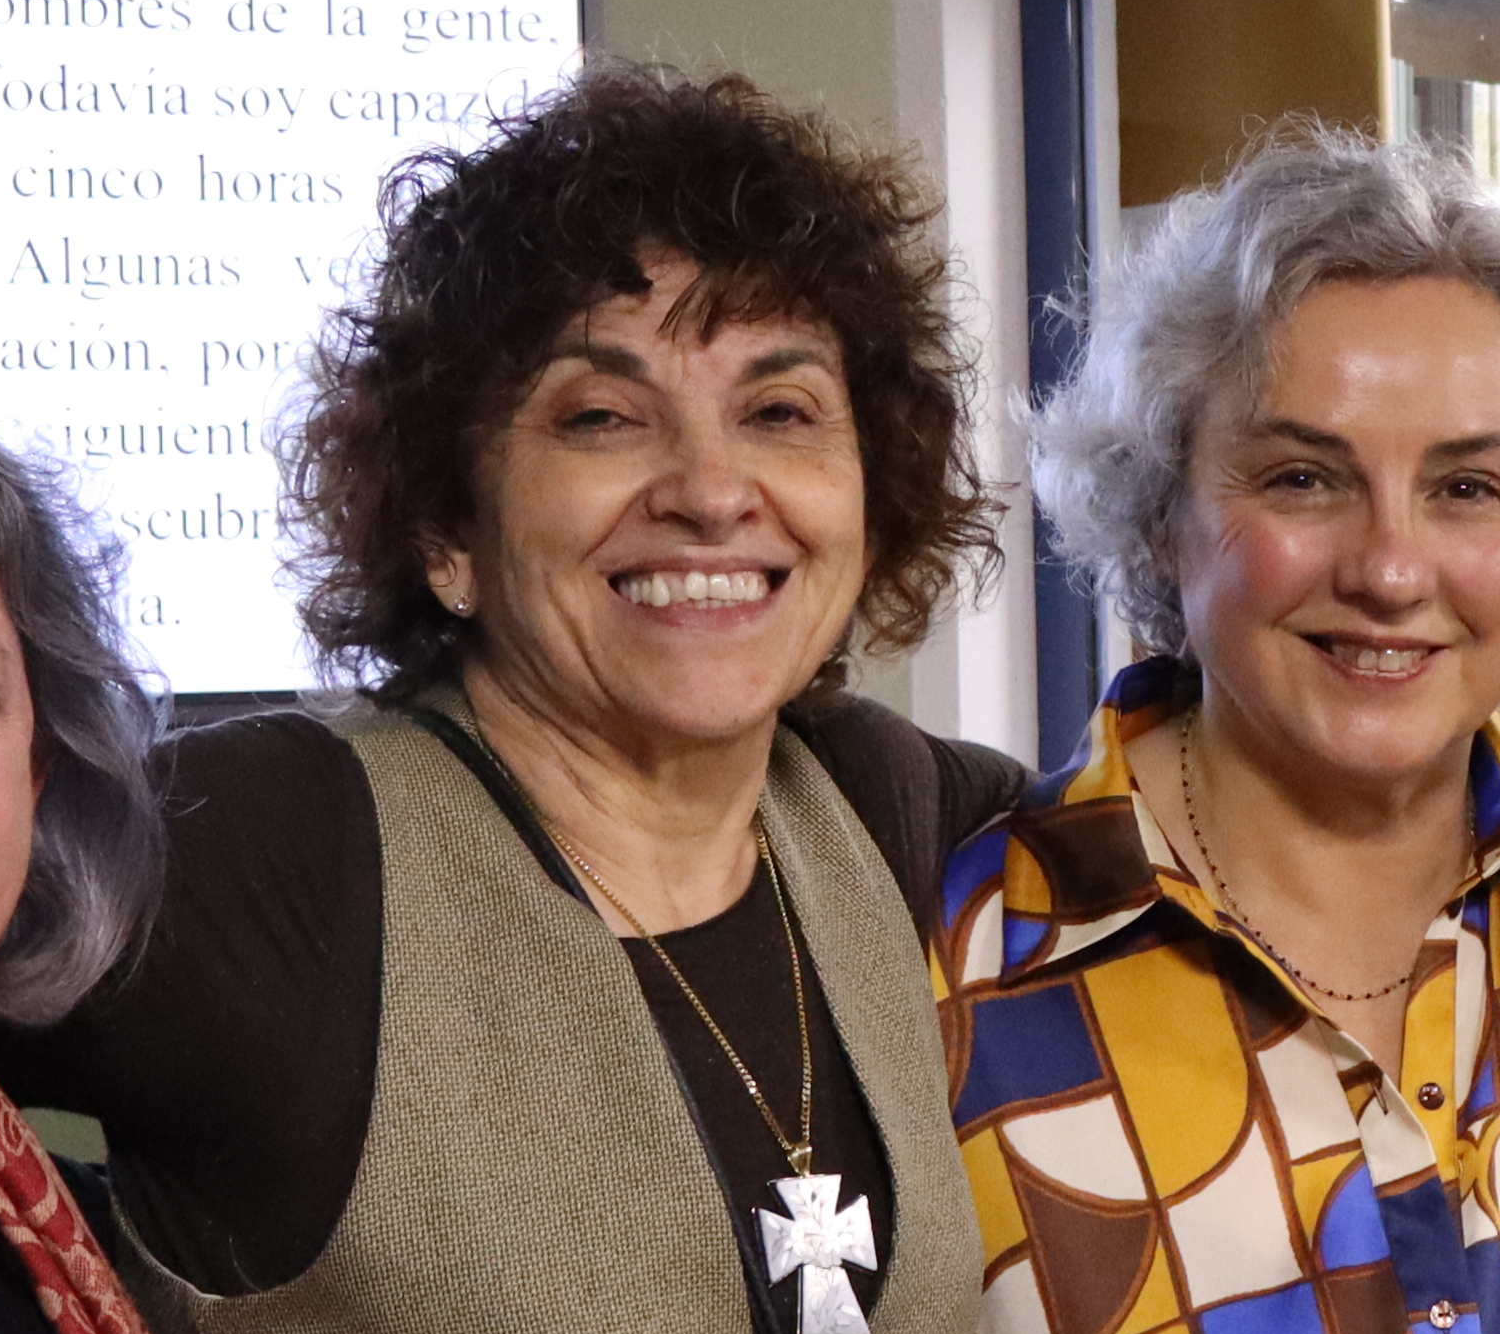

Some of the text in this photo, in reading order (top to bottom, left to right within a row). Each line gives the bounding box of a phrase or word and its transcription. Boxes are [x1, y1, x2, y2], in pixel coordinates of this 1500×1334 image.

[402, 5, 558, 55] gente,
[214, 87, 305, 134] soy
[329, 87, 483, 137] capaz
[11, 150, 164, 200] cinco
[197, 153, 343, 203] horas
[9, 236, 241, 301] Algunas
